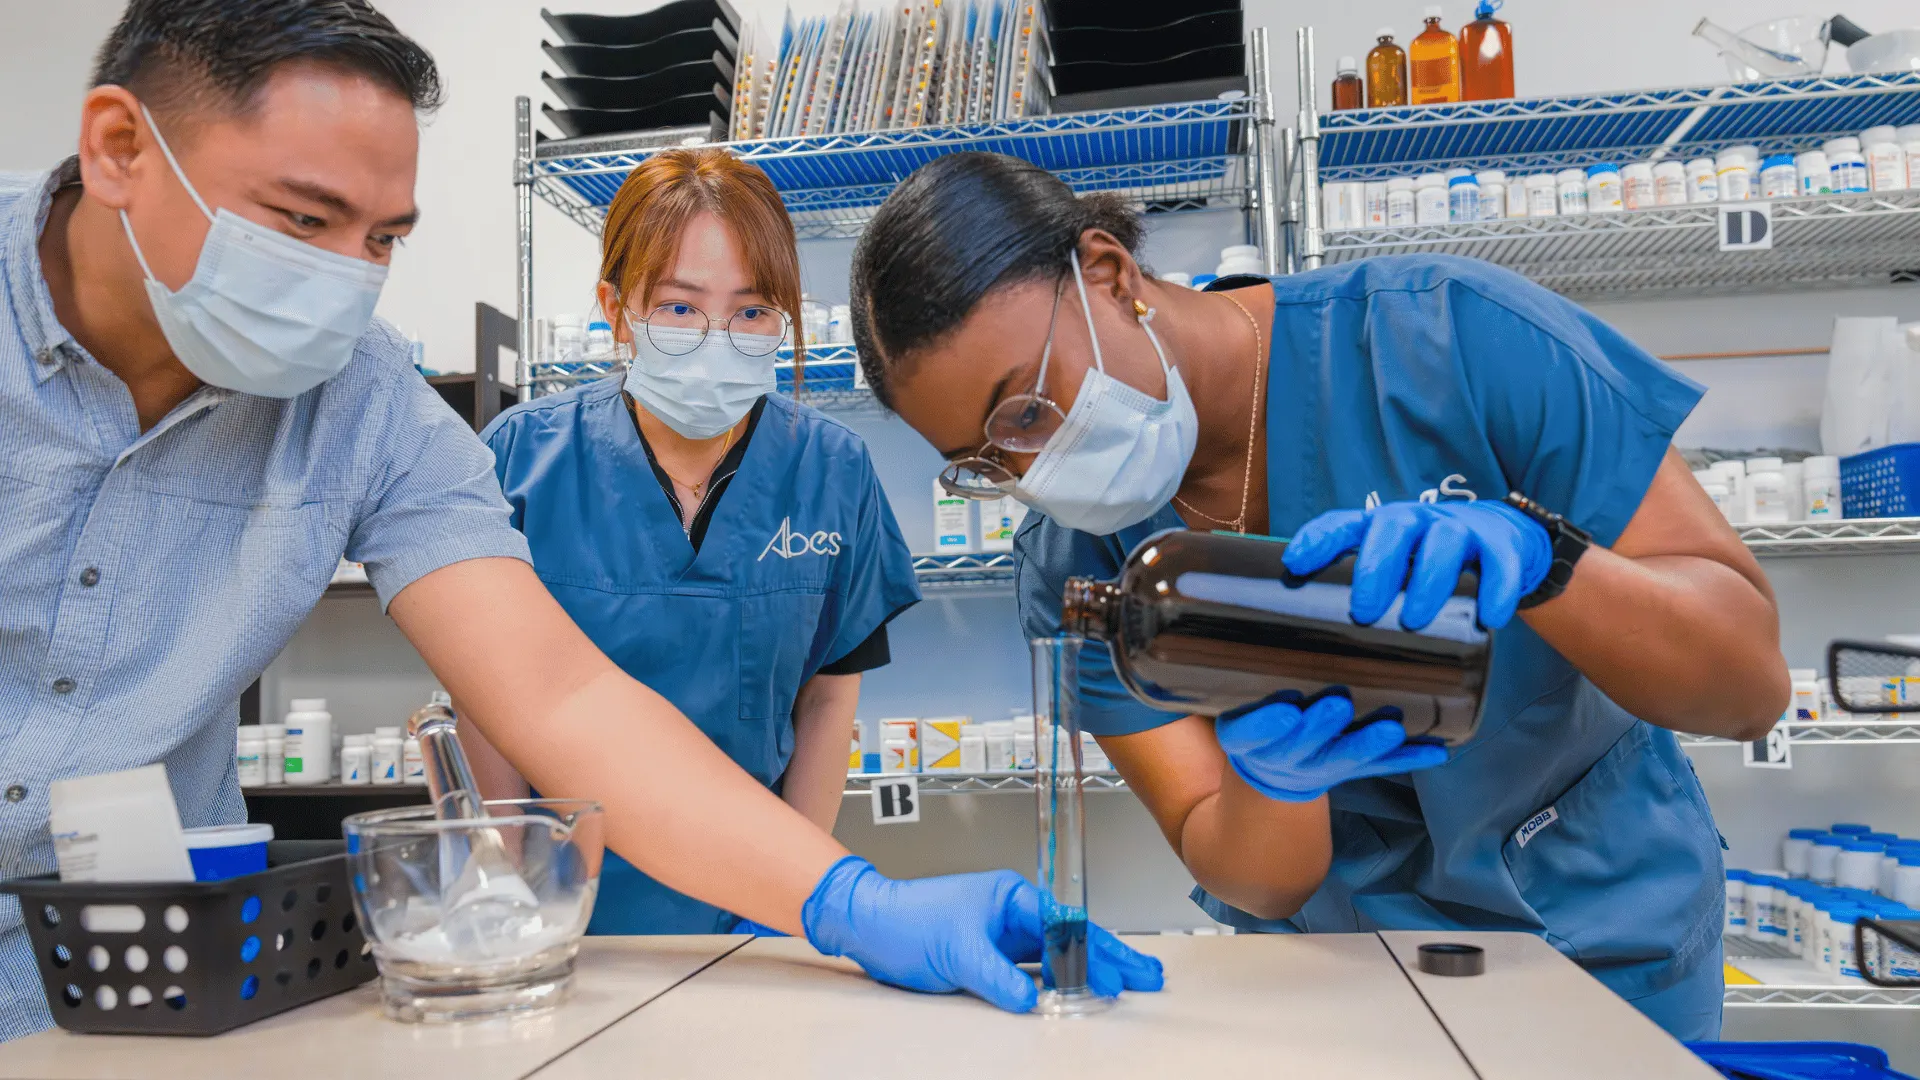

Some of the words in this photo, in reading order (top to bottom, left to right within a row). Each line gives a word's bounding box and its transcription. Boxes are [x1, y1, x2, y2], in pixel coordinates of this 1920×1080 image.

[1725, 210, 1768, 244] D
[757, 516, 842, 562] Abes
[879, 783, 914, 817] B
[1521, 811, 1552, 842] MOBB
